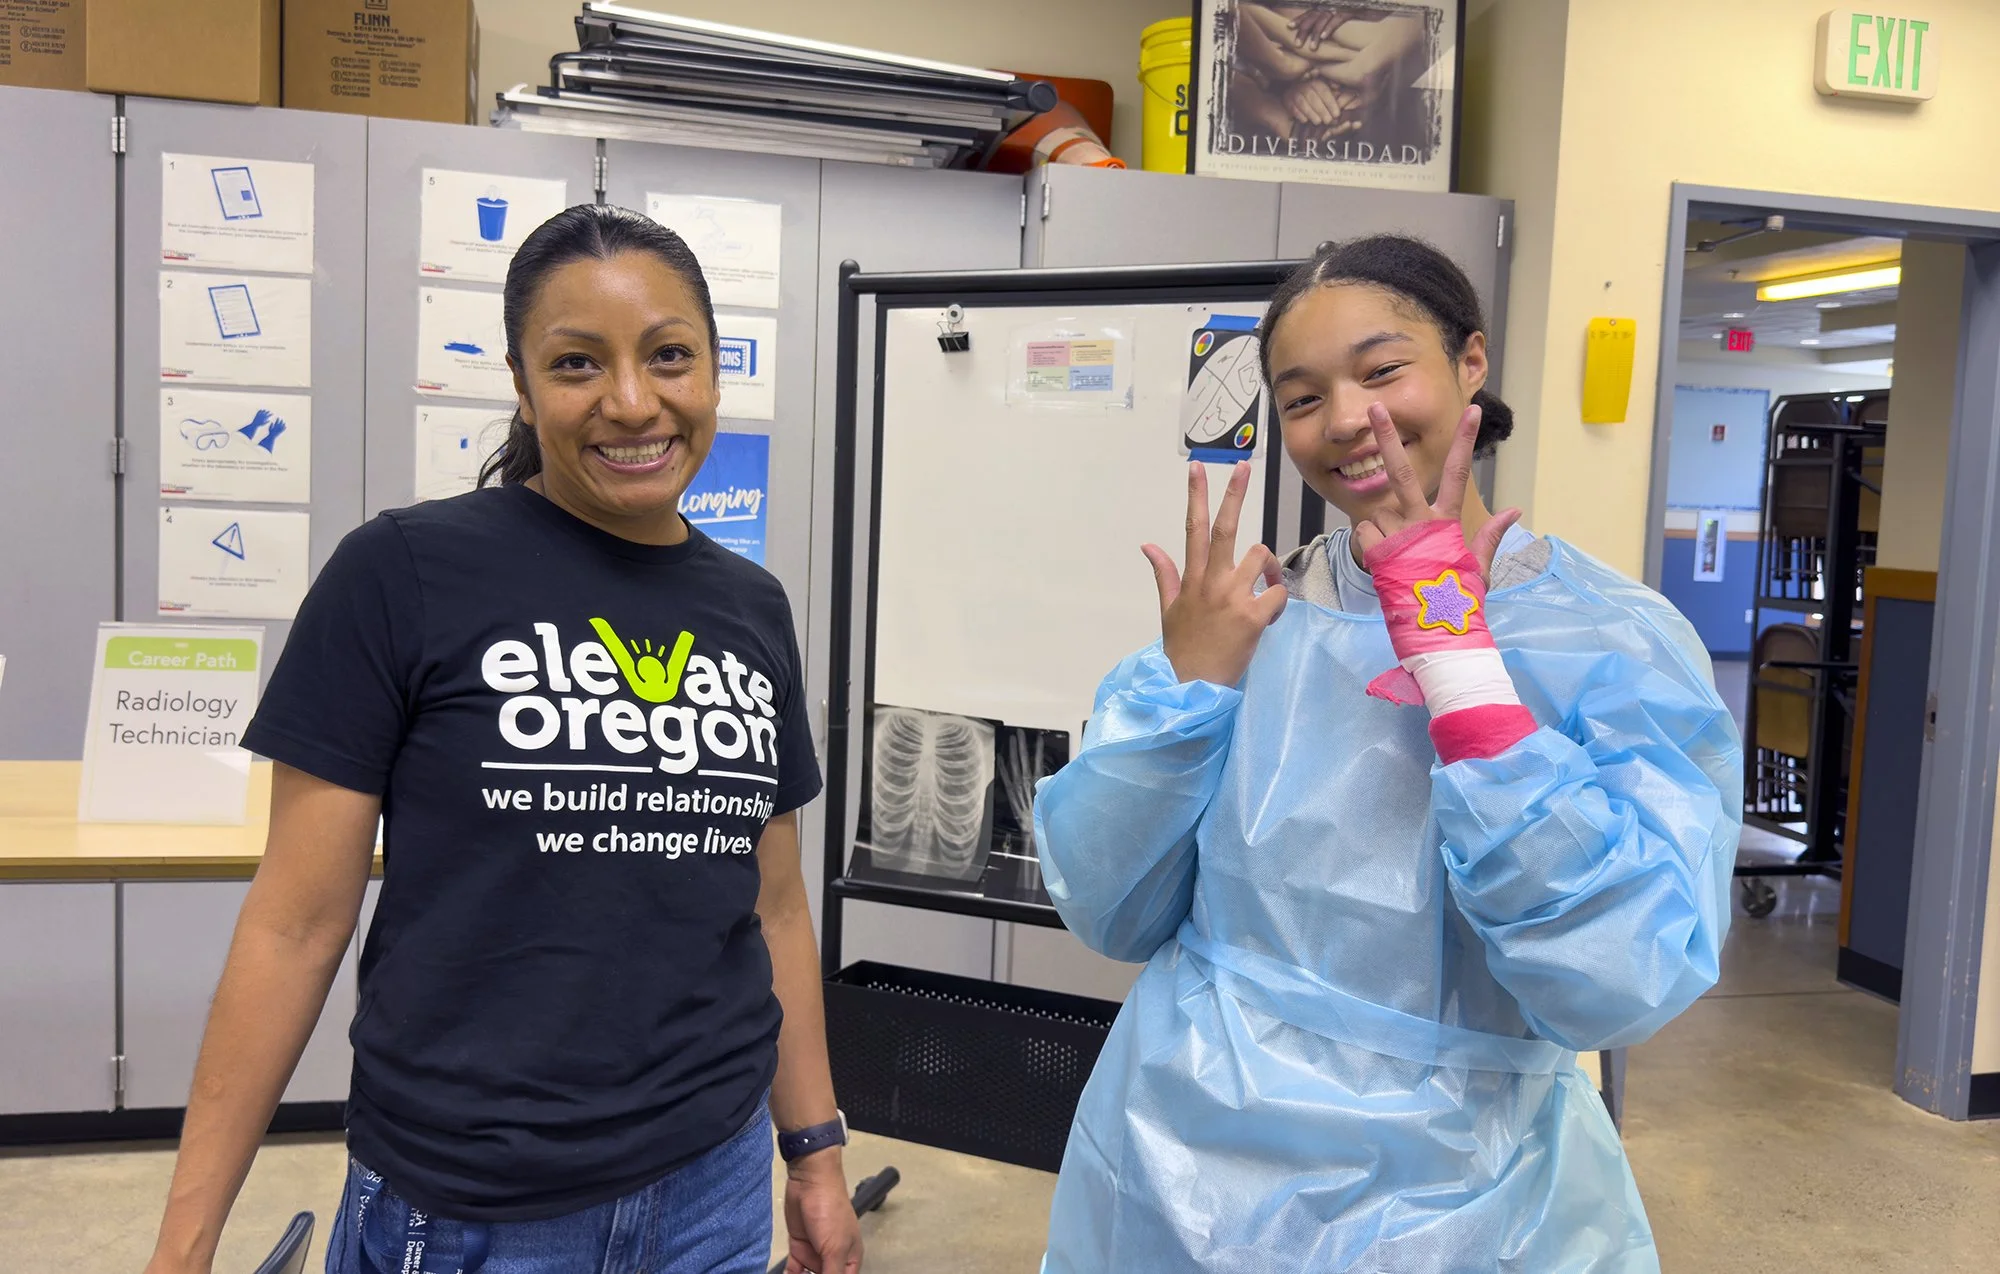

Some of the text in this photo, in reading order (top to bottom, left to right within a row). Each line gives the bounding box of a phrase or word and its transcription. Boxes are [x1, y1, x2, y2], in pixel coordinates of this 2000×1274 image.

[354, 12, 391, 28] FLINN
[1847, 13, 1930, 91] EXIT
[1228, 134, 1419, 165] DIVERSIDAD
[169, 161, 175, 170] 1
[429, 176, 436, 186] 5
[166, 280, 173, 288] 2
[426, 295, 433, 304] 6
[1728, 329, 1753, 352] EXIT
[720, 350, 742, 367] ONS
[167, 397, 174, 406] 3
[422, 413, 429, 422] 7
[677, 486, 765, 518] longing
[166, 515, 173, 524] 4
[128, 650, 237, 669] Career Path
[116, 690, 238, 719] Radiology
[109, 723, 237, 746] Technician
[499, 695, 778, 775] oregon
[482, 783, 774, 825] we build relationship
[536, 826, 752, 860] we change lives
[401, 1240, 416, 1274] Develop
[413, 1240, 425, 1269] Career
